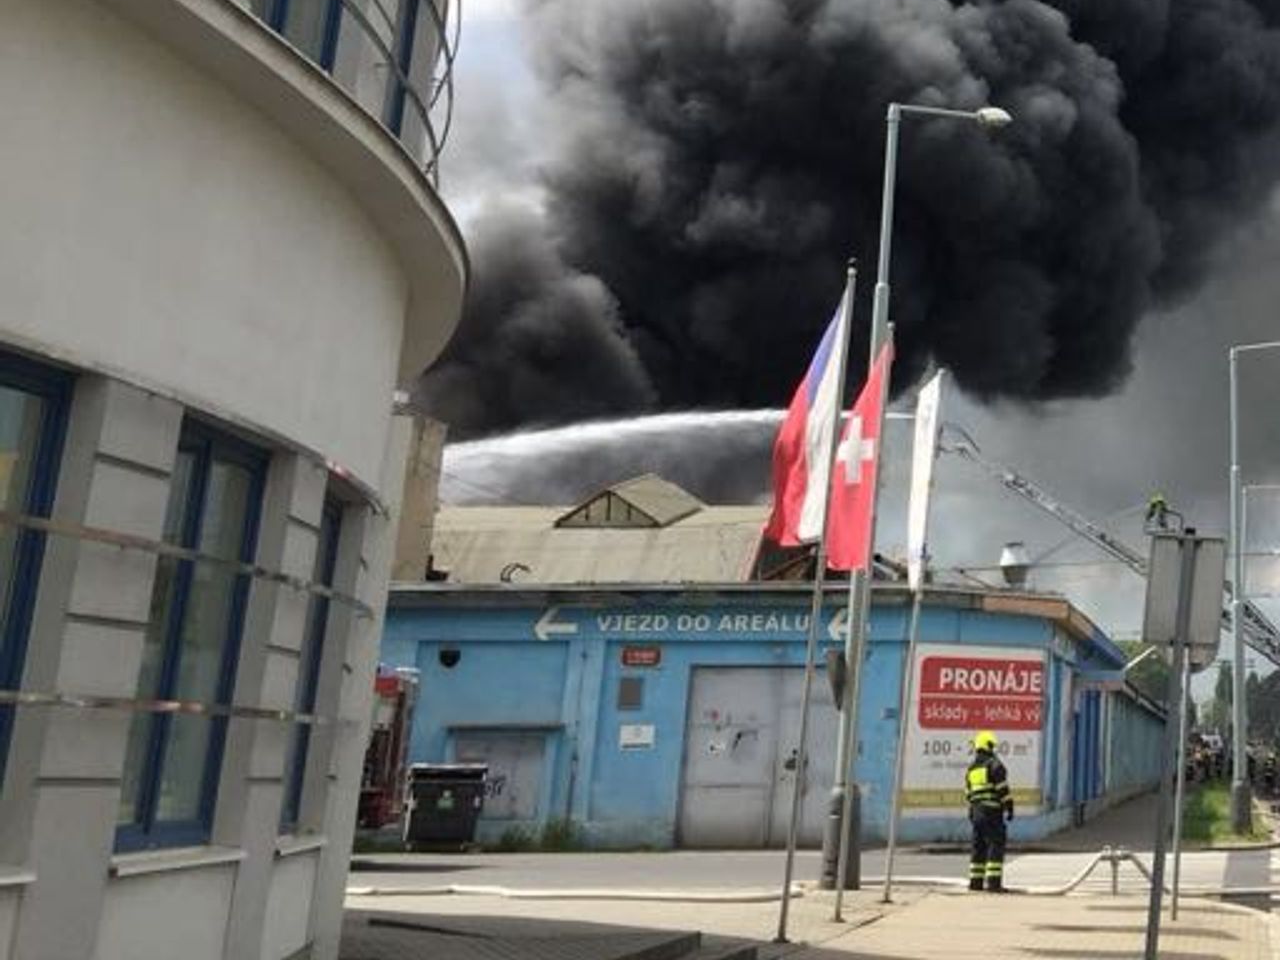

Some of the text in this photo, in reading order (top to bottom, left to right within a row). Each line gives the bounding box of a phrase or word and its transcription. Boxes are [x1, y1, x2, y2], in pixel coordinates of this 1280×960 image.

[598, 611, 811, 632] VJEZD DO AREÁLU
[939, 663, 1042, 692] PRONÁJE
[924, 702, 968, 723] sklady
[923, 740, 952, 756] 100
